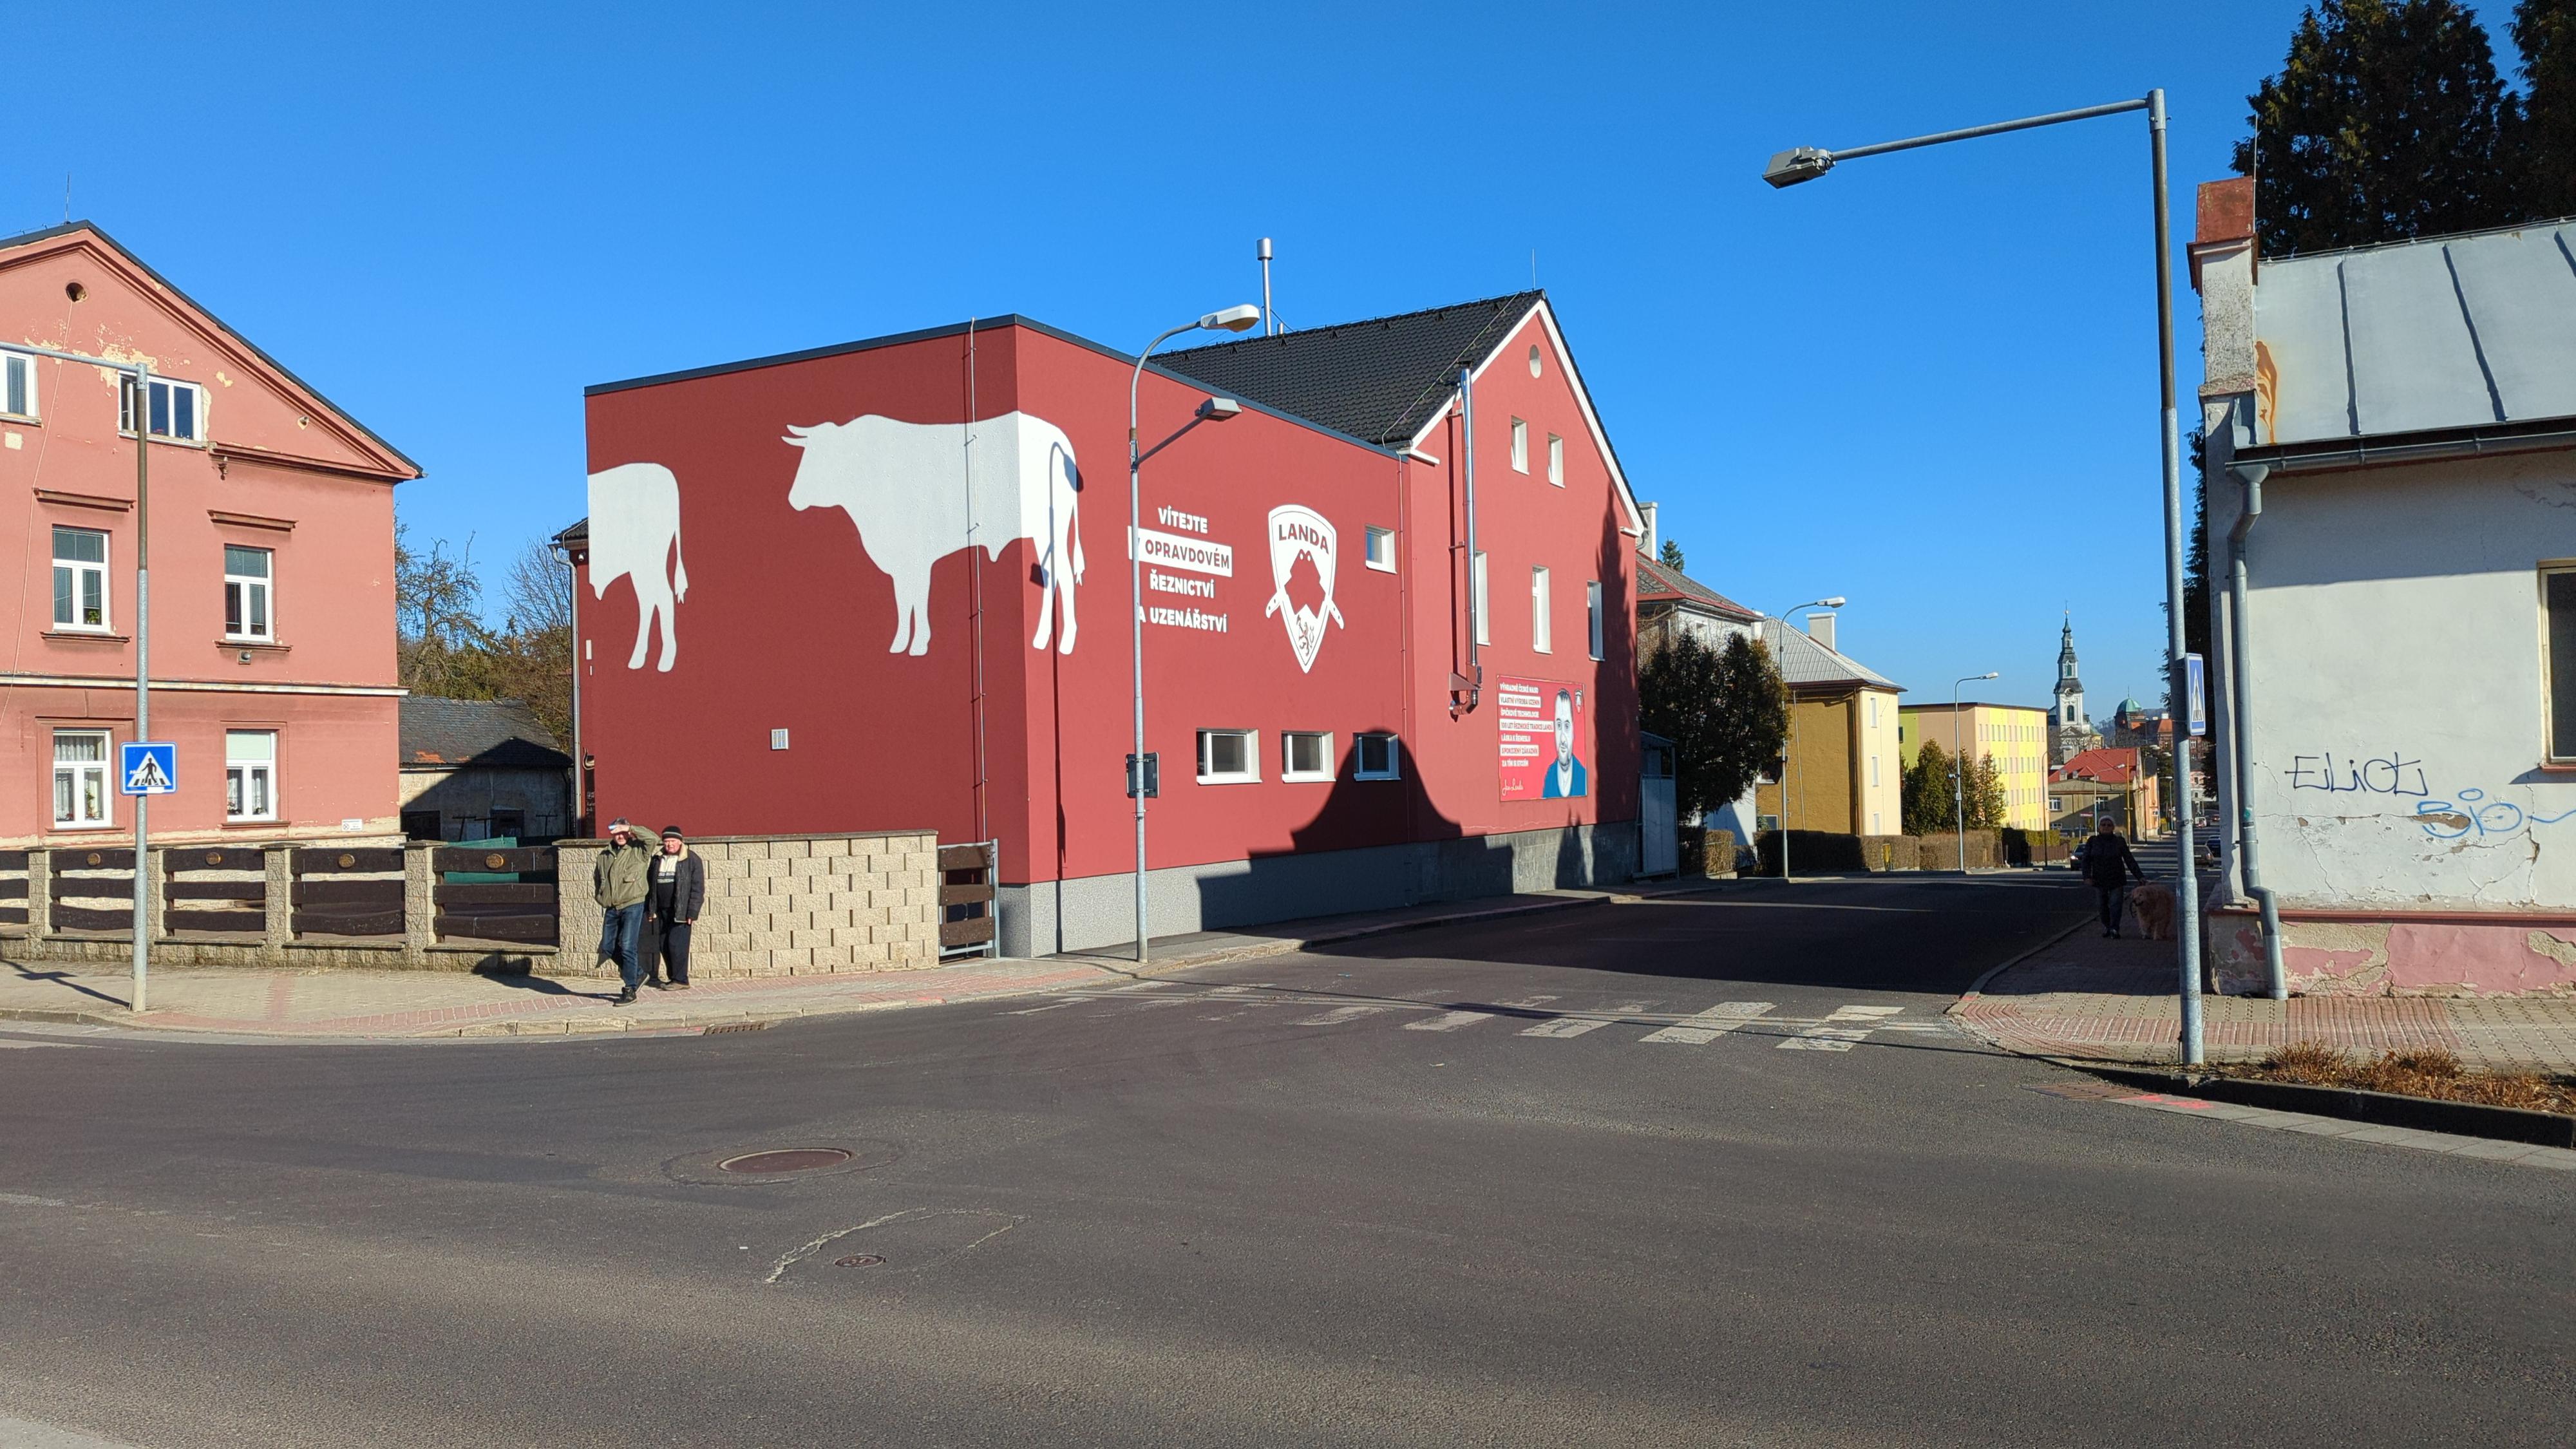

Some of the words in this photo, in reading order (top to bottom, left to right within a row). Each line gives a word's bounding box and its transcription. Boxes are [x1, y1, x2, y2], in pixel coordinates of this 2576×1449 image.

[1157, 504, 1208, 534] VÍTEJTE
[1145, 539, 1229, 569] OPRAVDOVÉM
[1278, 523, 1329, 555] LANDA
[1150, 568, 1215, 599] ŘEZNICTVÍ
[1150, 607, 1227, 633] UZENÁŘSTVÍ
